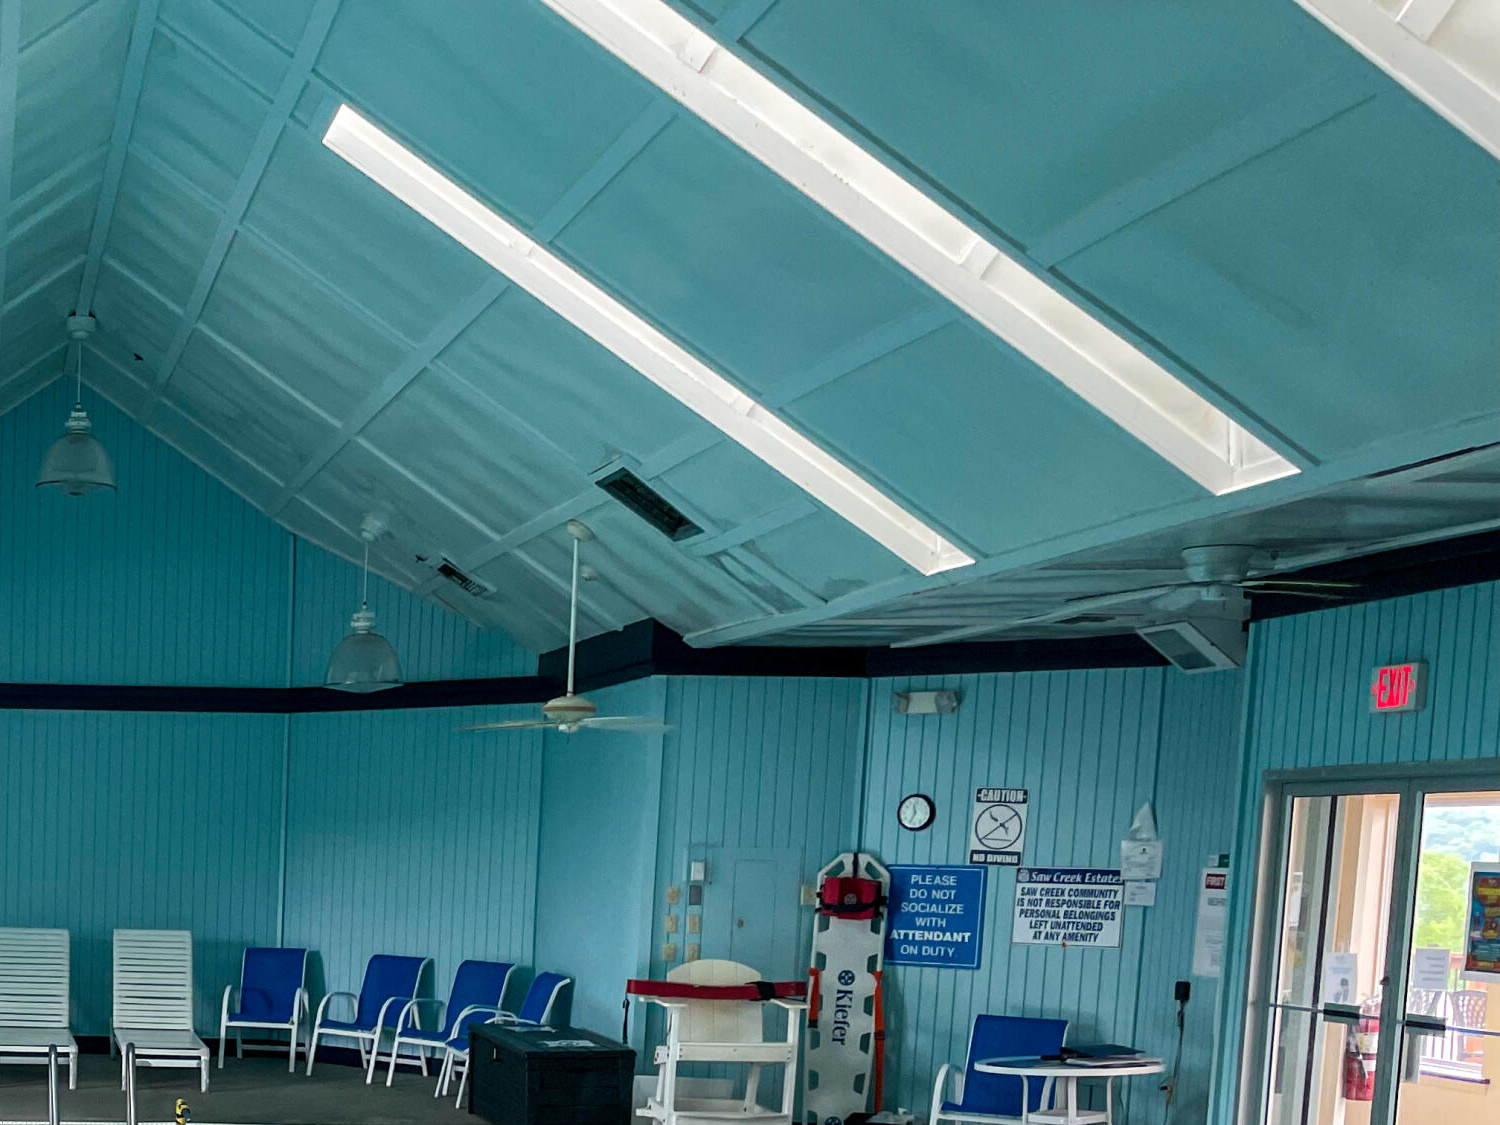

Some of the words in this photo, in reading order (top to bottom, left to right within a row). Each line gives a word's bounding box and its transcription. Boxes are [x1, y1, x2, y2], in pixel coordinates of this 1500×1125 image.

[1377, 665, 1412, 708] EXIT
[973, 854, 985, 862] NO
[987, 855, 1018, 863] DIVING
[911, 875, 957, 885] PLEASE
[1031, 872, 1052, 882] Saw
[1054, 872, 1081, 882] Creek
[910, 889, 927, 899] DO
[932, 890, 956, 899] NOT
[1021, 887, 1038, 896] SAW
[1040, 888, 1066, 897] CREEK
[1068, 888, 1119, 899] COMMUNITY
[901, 902, 964, 914] SOCIALIZE
[1017, 898, 1025, 906] IS
[1027, 899, 1042, 907] NOT
[1045, 899, 1101, 909] RESPONSIBLE
[1104, 900, 1120, 910] FOR
[1019, 909, 1060, 919] PERSONAL
[1063, 910, 1115, 920] BELONGINGS
[915, 917, 946, 927] WITH
[1029, 920, 1048, 929] LEFT
[1050, 921, 1103, 931] UNATTENDED
[891, 929, 971, 942] ATTENDANT
[1032, 931, 1042, 940] AT
[1044, 932, 1060, 940] ANY
[1062, 932, 1099, 942] AMENITY
[900, 945, 918, 955] ON
[922, 946, 955, 957] DUTY
[832, 989, 853, 1045] Kiefer
